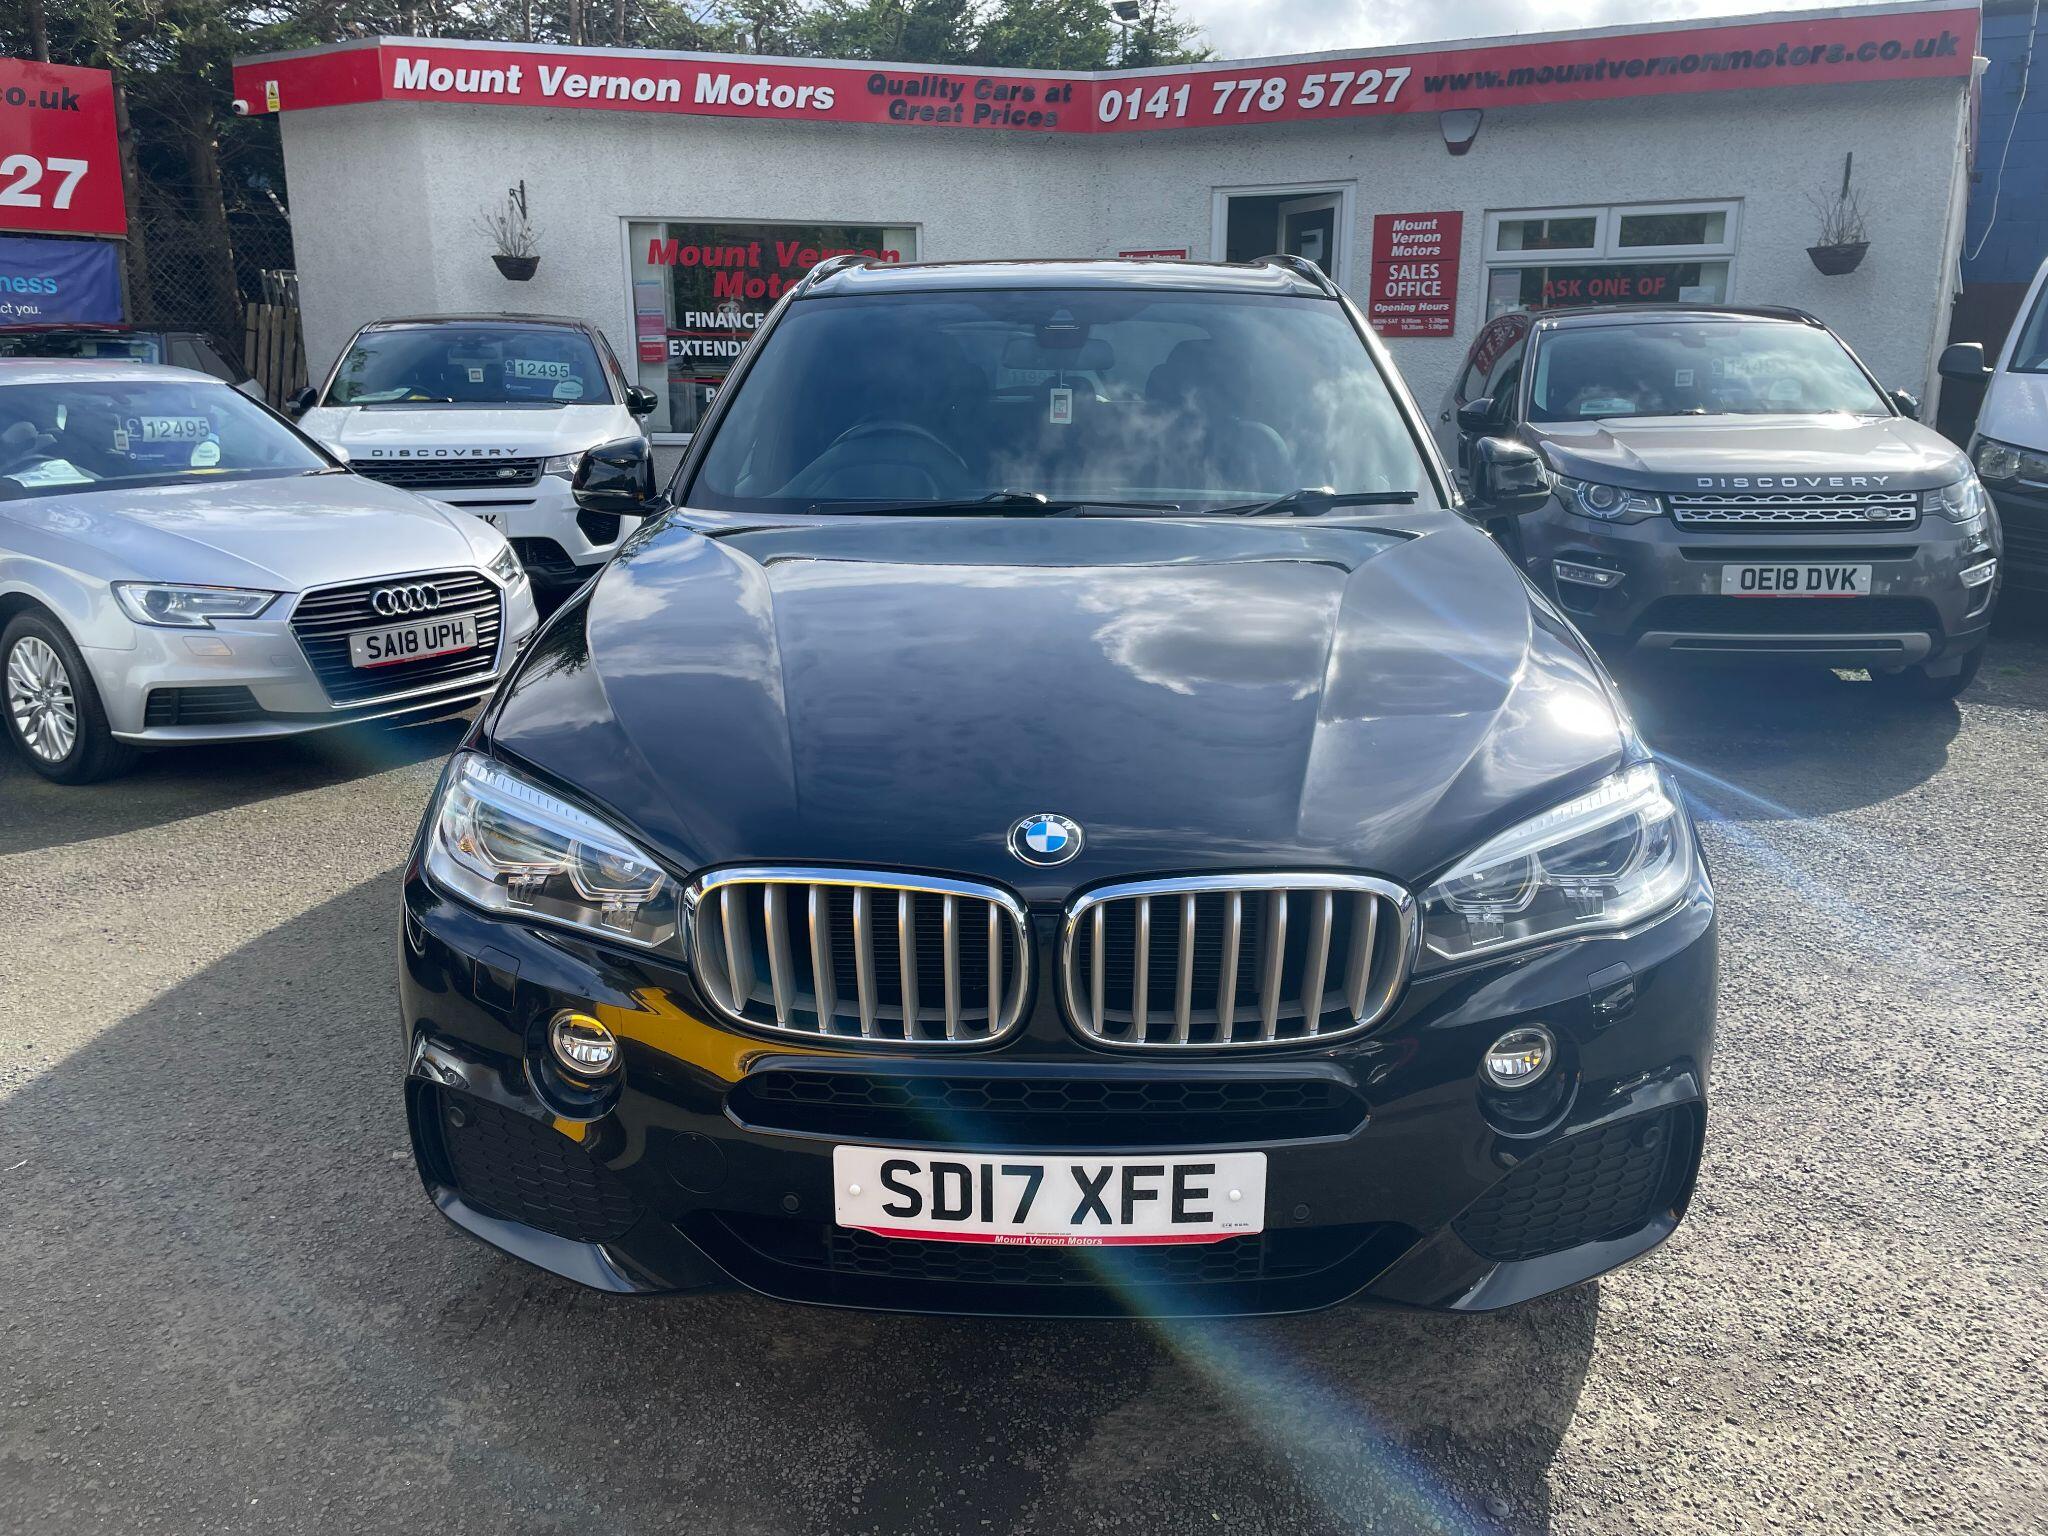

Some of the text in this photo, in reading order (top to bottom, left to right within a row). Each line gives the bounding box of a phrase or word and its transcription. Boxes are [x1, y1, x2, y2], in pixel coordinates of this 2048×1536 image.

[1423, 31, 1958, 93] www.mountvernonmotors.co.uk
[393, 58, 835, 110] Mount Vernon Motors
[867, 73, 1073, 103] Quality Cars at
[0, 87, 80, 111] o.uk
[1098, 67, 1411, 122] 0141 778 5727
[889, 99, 1058, 127] Great Prices
[1392, 219, 1438, 231] Mount
[1391, 233, 1441, 243] Vernon
[648, 239, 761, 268] Mount
[1391, 246, 1440, 256] Motors
[1389, 264, 1440, 280] SALES
[1385, 281, 1442, 297] OFFICE
[1541, 277, 1666, 298] ASK ONE OF
[15, 305, 42, 317] you.
[1374, 303, 1449, 313] Opening Hours
[669, 339, 748, 356] EXTEND
[517, 362, 569, 377] 12495
[147, 420, 210, 438] 12495
[371, 448, 518, 457] DISCOVERY
[1696, 476, 1889, 488] DISCOVERY
[1740, 568, 1858, 591] OE18 DVK
[366, 621, 465, 660] SA18 UPH
[1020, 815, 1077, 829] BMW
[880, 1159, 1217, 1226] SD17 XFE
[994, 1235, 1103, 1246] Mount Vernon Motors
